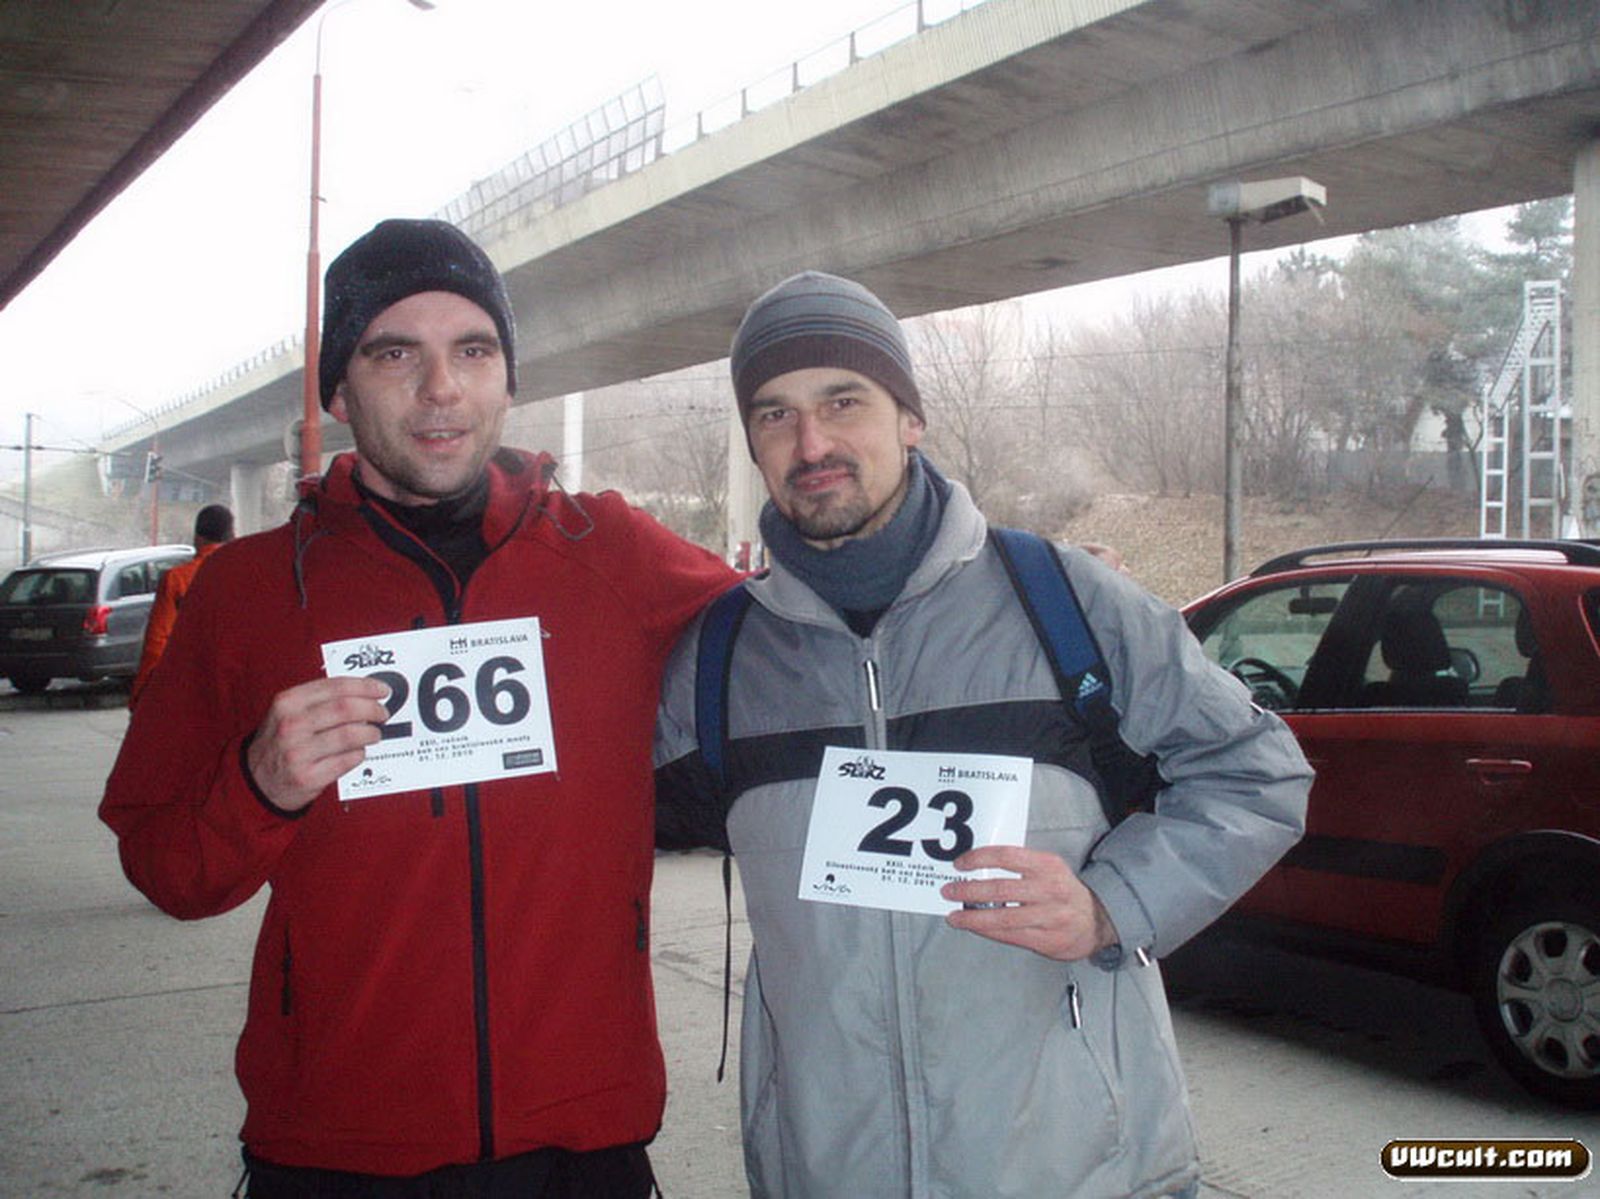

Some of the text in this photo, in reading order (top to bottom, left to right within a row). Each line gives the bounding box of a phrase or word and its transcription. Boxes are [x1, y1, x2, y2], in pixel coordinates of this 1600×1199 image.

[470, 634, 528, 648] BRATISLAVA
[363, 655, 531, 741] 266
[958, 768, 1018, 782] BRATISLAVA
[857, 785, 975, 862] 23
